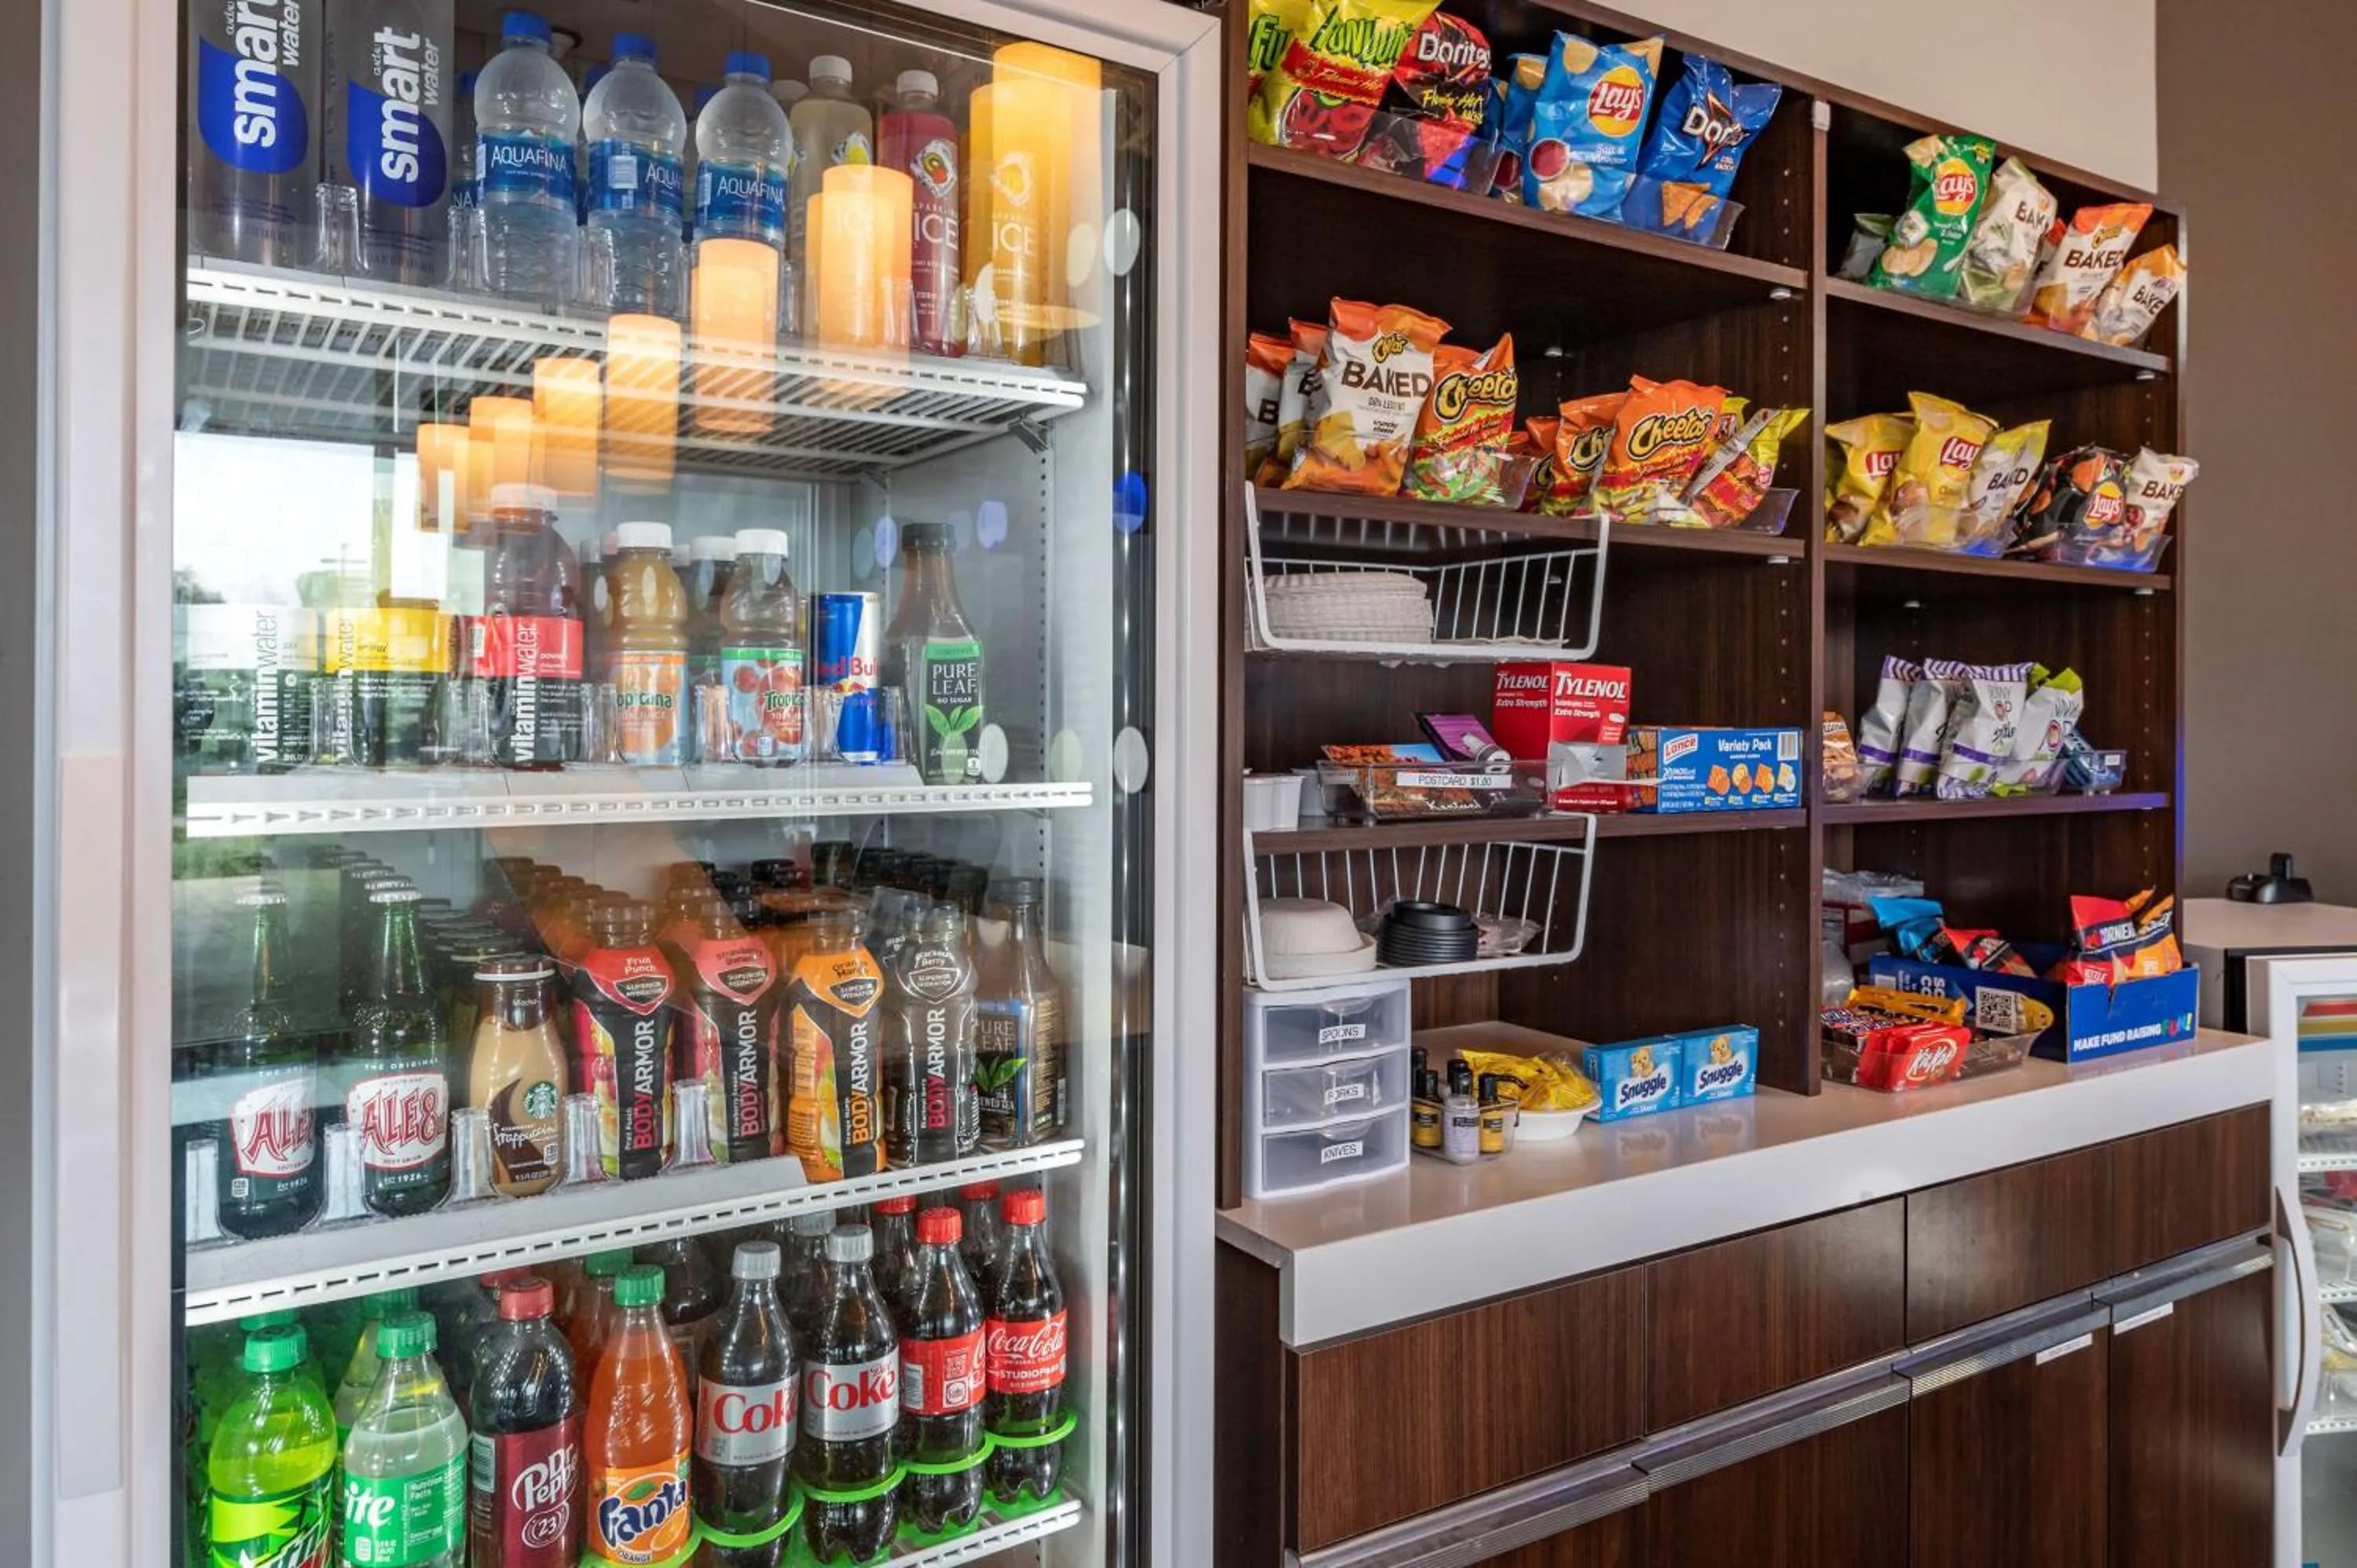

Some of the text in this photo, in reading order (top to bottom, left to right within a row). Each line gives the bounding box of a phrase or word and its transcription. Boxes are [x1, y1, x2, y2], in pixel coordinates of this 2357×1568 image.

[233, 0, 277, 148] smar
[422, 38, 440, 105] water
[381, 26, 420, 182] smart
[492, 145, 567, 172] AQUAFINA
[914, 212, 958, 251] ICE
[2015, 200, 2050, 233] BAK
[992, 222, 1036, 256] ICE
[2132, 285, 2165, 315] BAKE
[1341, 361, 1432, 397] BAKED
[1629, 407, 1712, 460] Cheetos
[1942, 438, 1980, 470] Lay
[251, 610, 278, 762] vitaminwater
[933, 663, 978, 680] PURE
[933, 679, 977, 695] LEAF
[1496, 672, 1549, 691] TYLENOL
[1555, 672, 1626, 698] TYLENOL
[511, 617, 538, 762] vitaminwater
[1666, 738, 1695, 757] Lance
[1718, 738, 1772, 753] Variety Pack
[1419, 775, 1491, 786] POSTCARD $1.00
[981, 1020, 1014, 1036] URE
[981, 1035, 1014, 1051] EAF
[1321, 1025, 1358, 1042] SPOONS
[2073, 1038, 2100, 1052] MAKE
[2101, 1031, 2125, 1046] FUND
[2127, 1024, 2161, 1041] RAISING
[739, 1009, 759, 1137] BODYARMOR
[850, 1022, 869, 1145] BODYARMOR
[926, 1006, 946, 1130] BODYARMOR
[1699, 1061, 1743, 1090] Snuggle
[634, 1020, 654, 1150] BODYARMOR
[1620, 1073, 1666, 1104] Snuggle
[1324, 1144, 1357, 1160] KNIVES
[806, 1369, 896, 1411] Coke
[713, 1387, 797, 1434] Cok
[548, 1443, 574, 1478] Dr
[345, 1482, 395, 1528] ite
[599, 1480, 687, 1548] Fanta
[538, 1517, 555, 1537] 23
